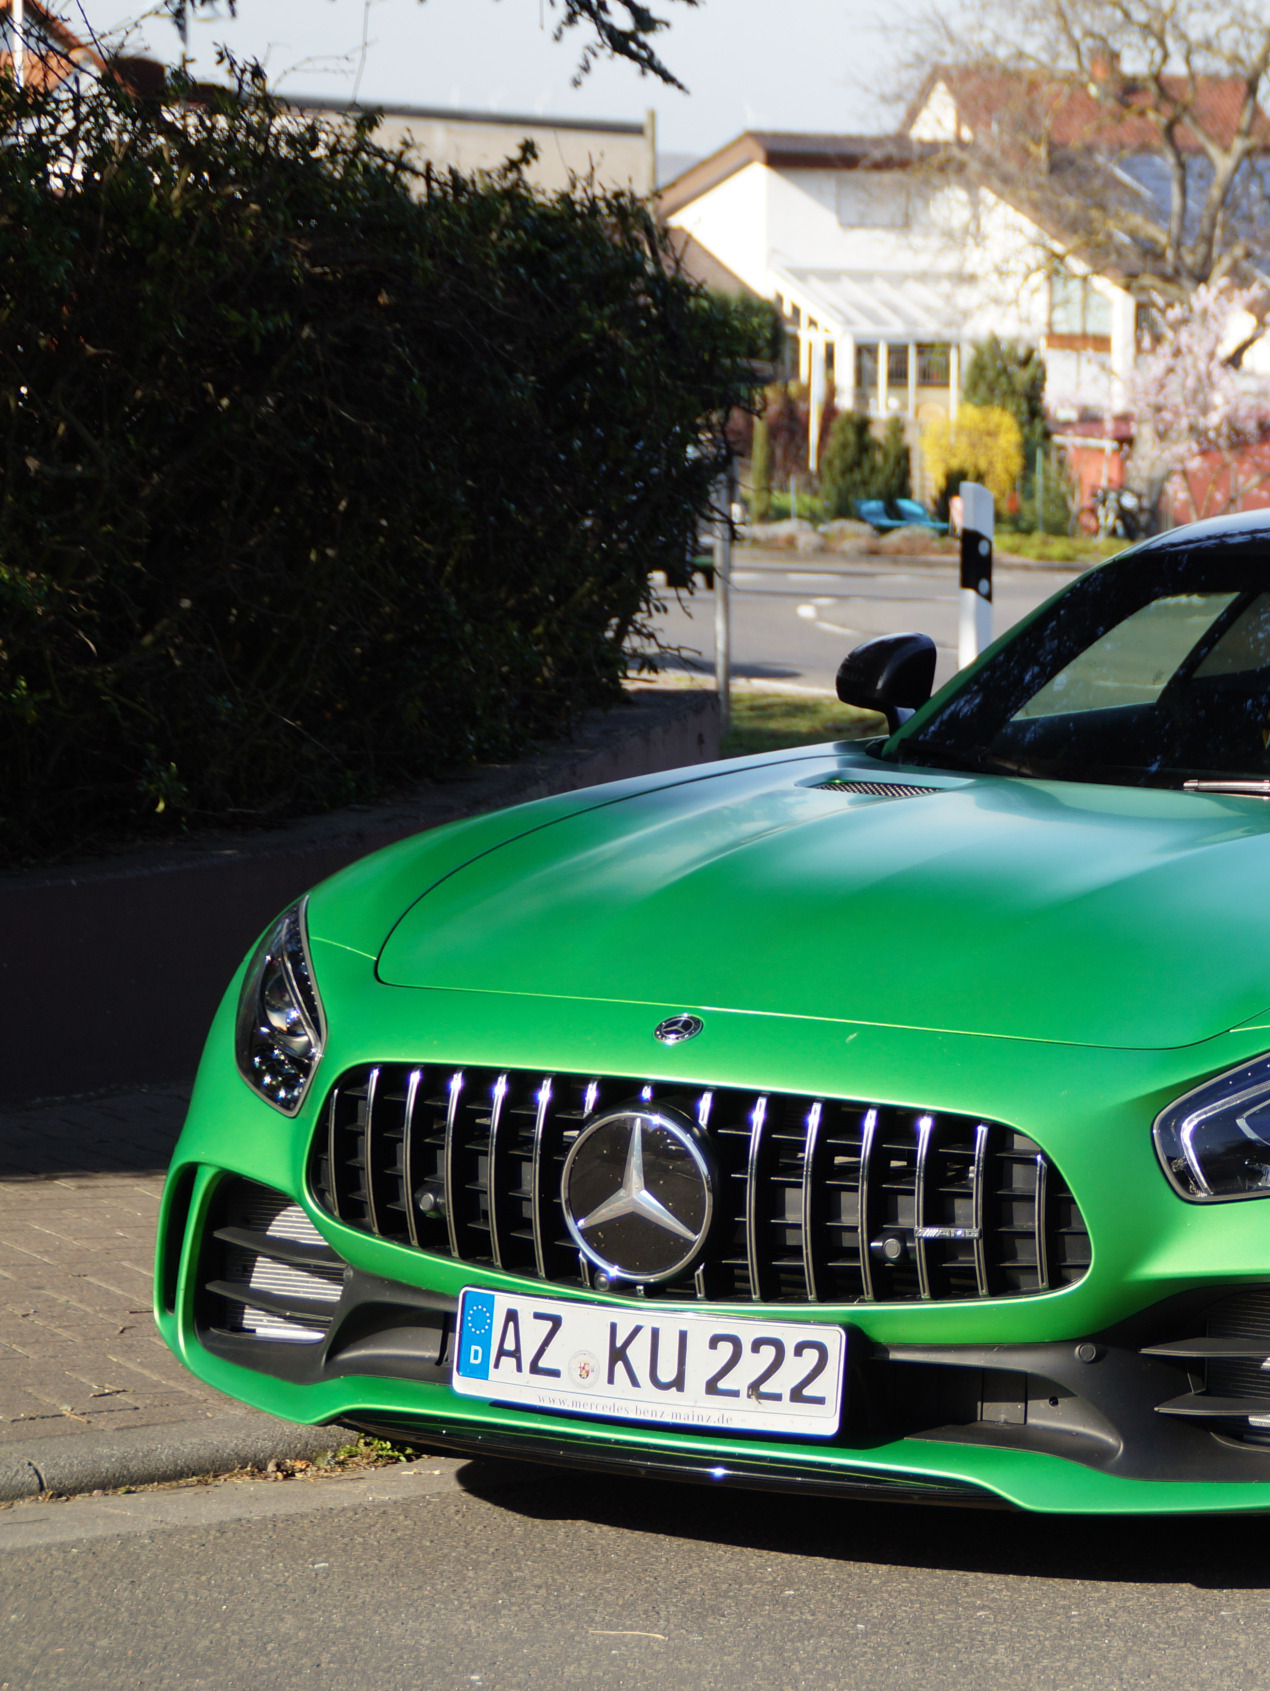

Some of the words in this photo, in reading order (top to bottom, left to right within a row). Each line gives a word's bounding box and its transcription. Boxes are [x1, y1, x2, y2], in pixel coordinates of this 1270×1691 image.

[470, 1345, 482, 1364] D
[493, 1308, 563, 1378] AZ
[607, 1322, 688, 1393] KU
[704, 1333, 830, 1405] 222
[537, 1394, 733, 1425] www.mercedes-benz-mainz.de
